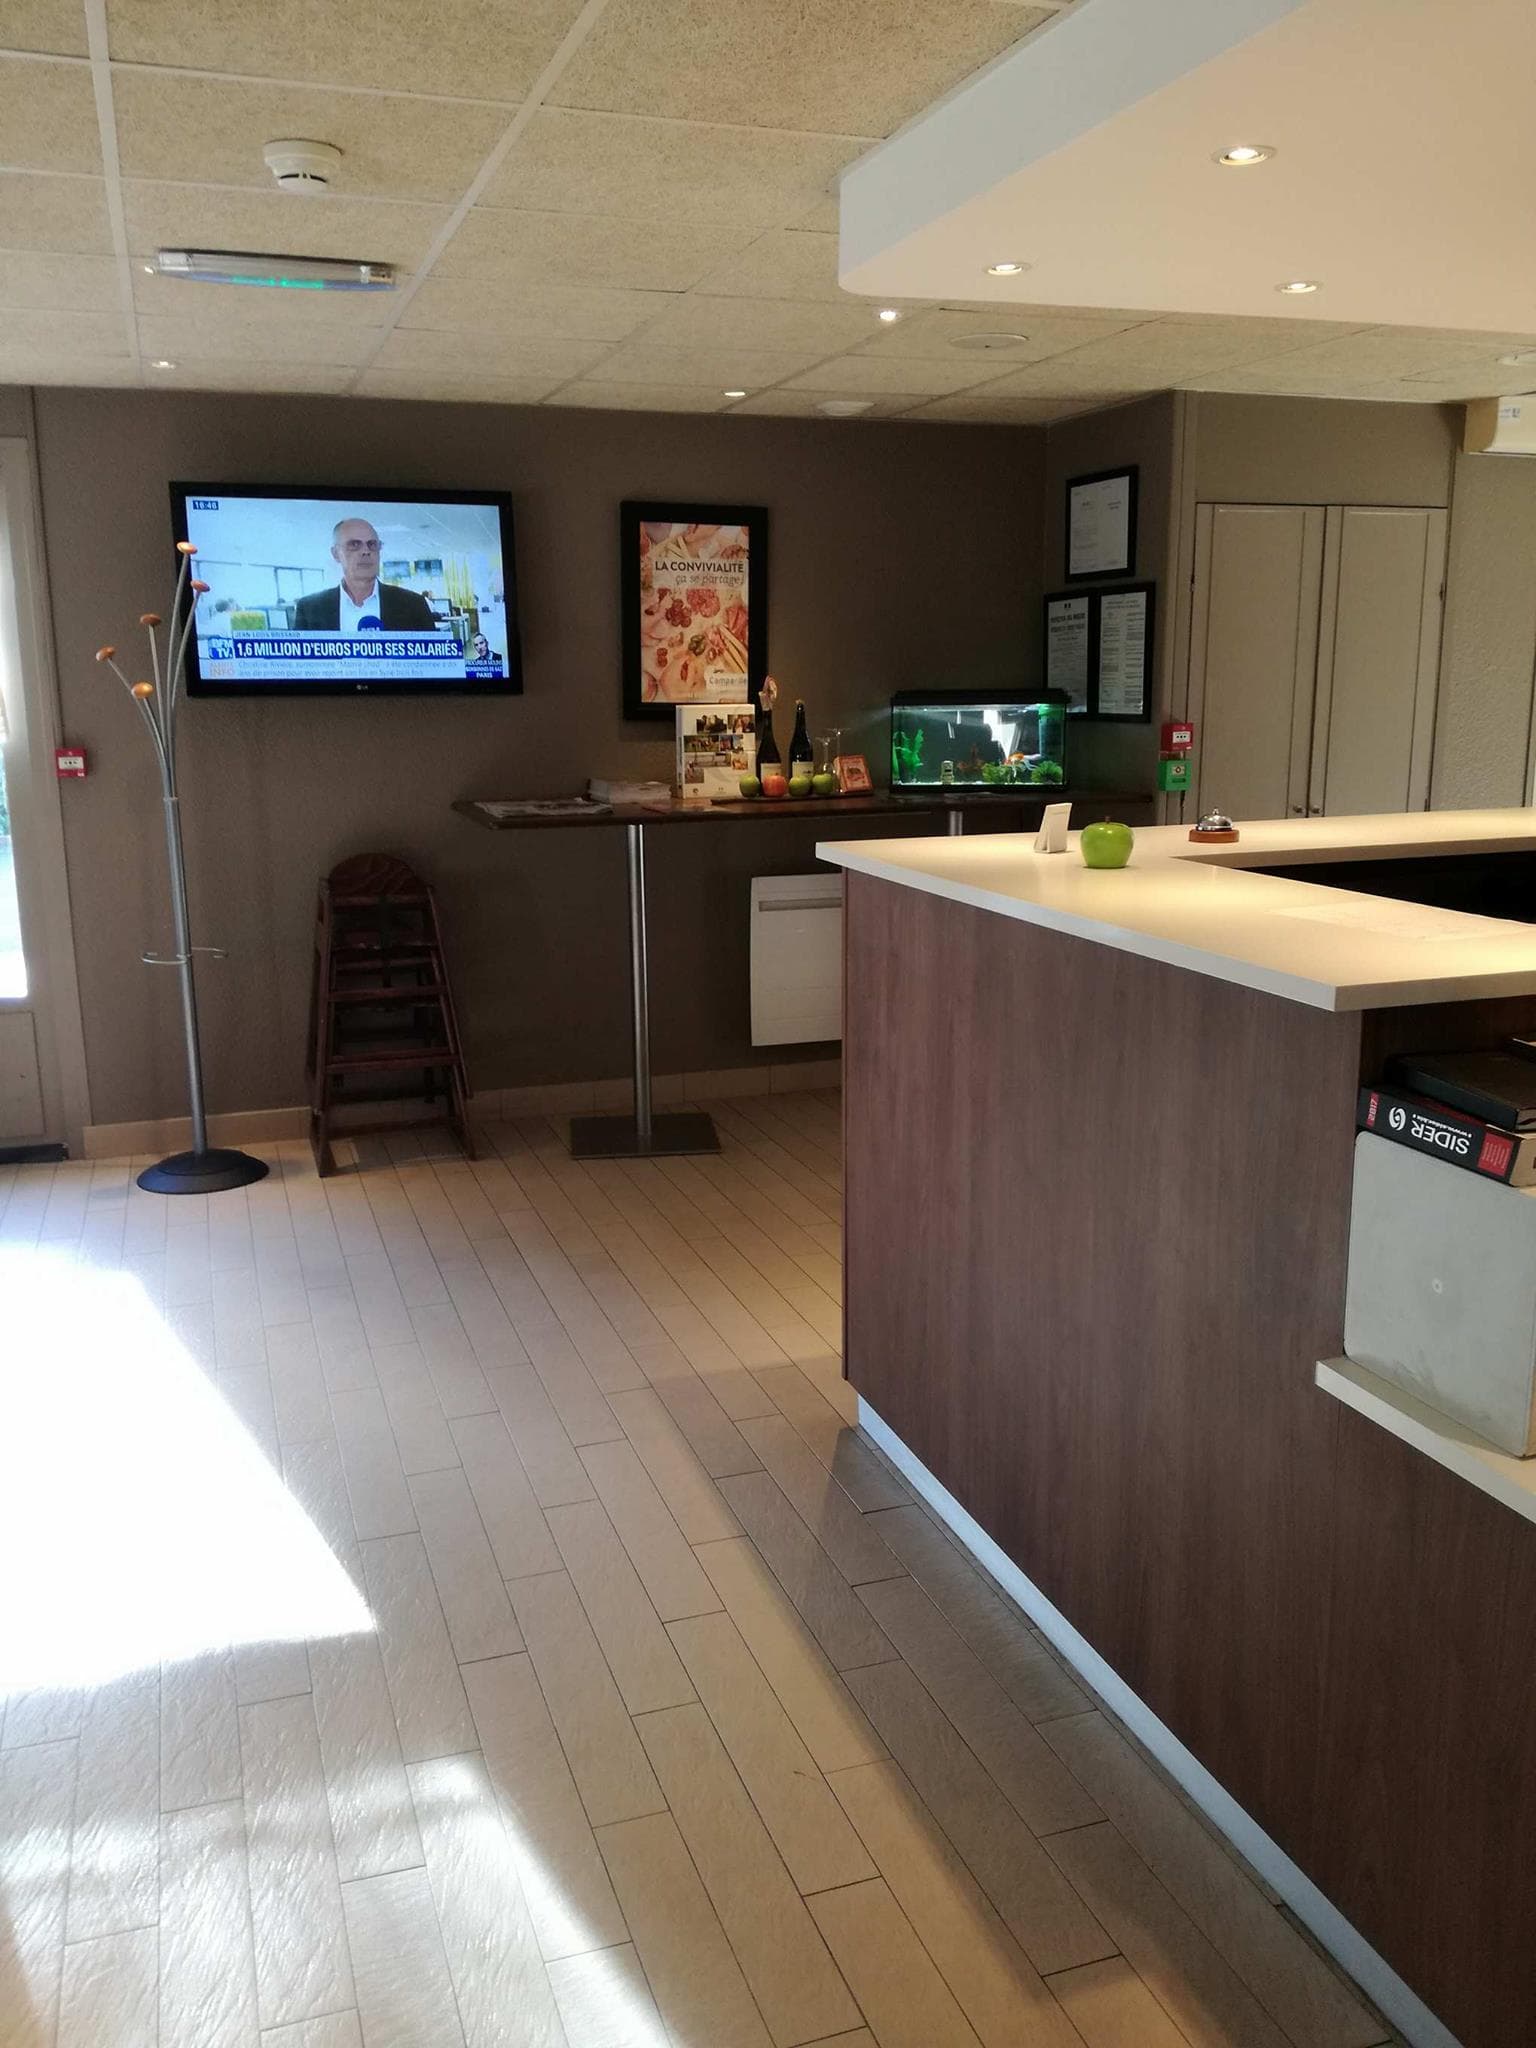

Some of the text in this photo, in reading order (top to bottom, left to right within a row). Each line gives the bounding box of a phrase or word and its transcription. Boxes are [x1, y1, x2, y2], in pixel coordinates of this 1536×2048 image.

[655, 560, 744, 573] LA CONVIVIALITÉ
[255, 642, 301, 657] MILLION
[303, 642, 351, 657] D'EUROS
[353, 642, 383, 657] POUR
[384, 642, 405, 657] SES
[1411, 1120, 1470, 1155] SIDER
